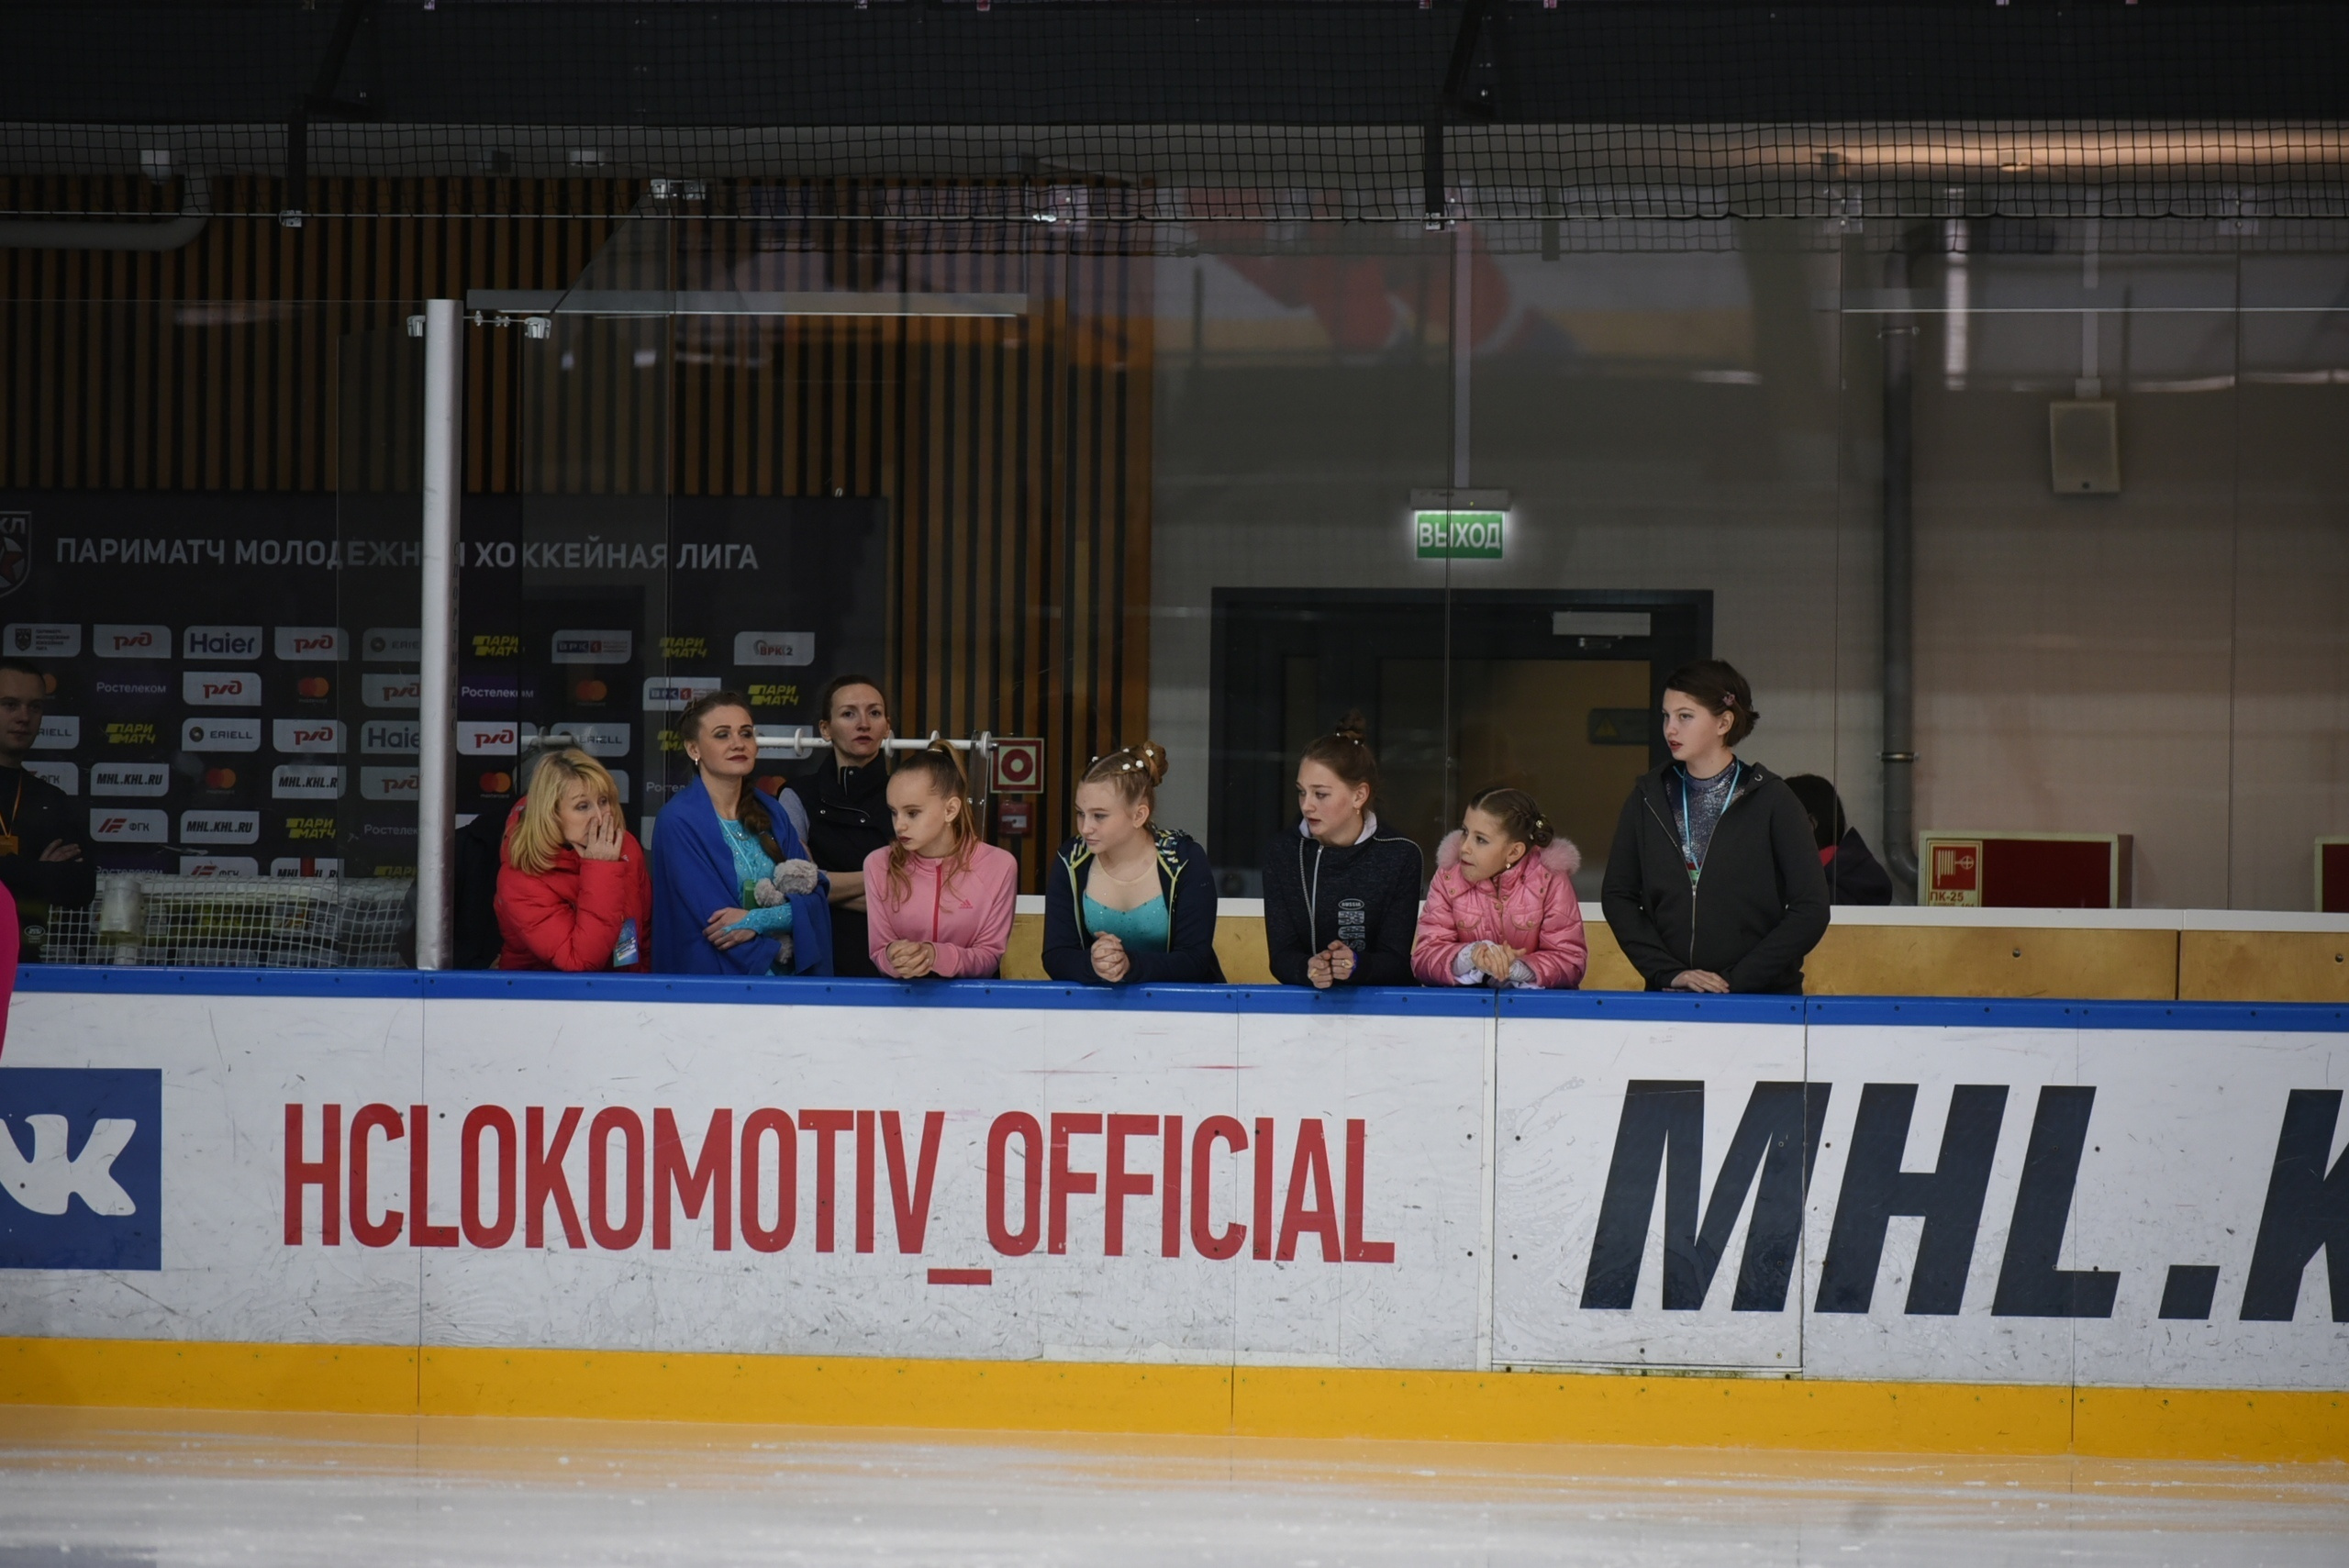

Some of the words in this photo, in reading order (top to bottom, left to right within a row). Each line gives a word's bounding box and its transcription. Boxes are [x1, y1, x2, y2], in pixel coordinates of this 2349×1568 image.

[1419, 522, 1500, 550] ВЫХОД
[57, 538, 225, 565] ПАРИМАТЧ
[474, 535, 668, 569] ХОККЕЙНАЯ
[676, 543, 759, 570] ЛИГА
[190, 632, 255, 653] Haier
[96, 681, 166, 694] Ростелеком
[38, 728, 72, 737] RIELL
[368, 727, 420, 748] Haie
[96, 773, 163, 785] MHL.KHL.RU
[278, 776, 338, 788] MHL.KHL.R
[128, 822, 150, 832] ФГК
[186, 820, 253, 833] MHL.KHL.RU
[363, 824, 418, 835] Ростелек
[1930, 891, 1965, 902] ПК-25
[284, 1103, 1395, 1285] HCLOKOMOTIV_OFFICIAL
